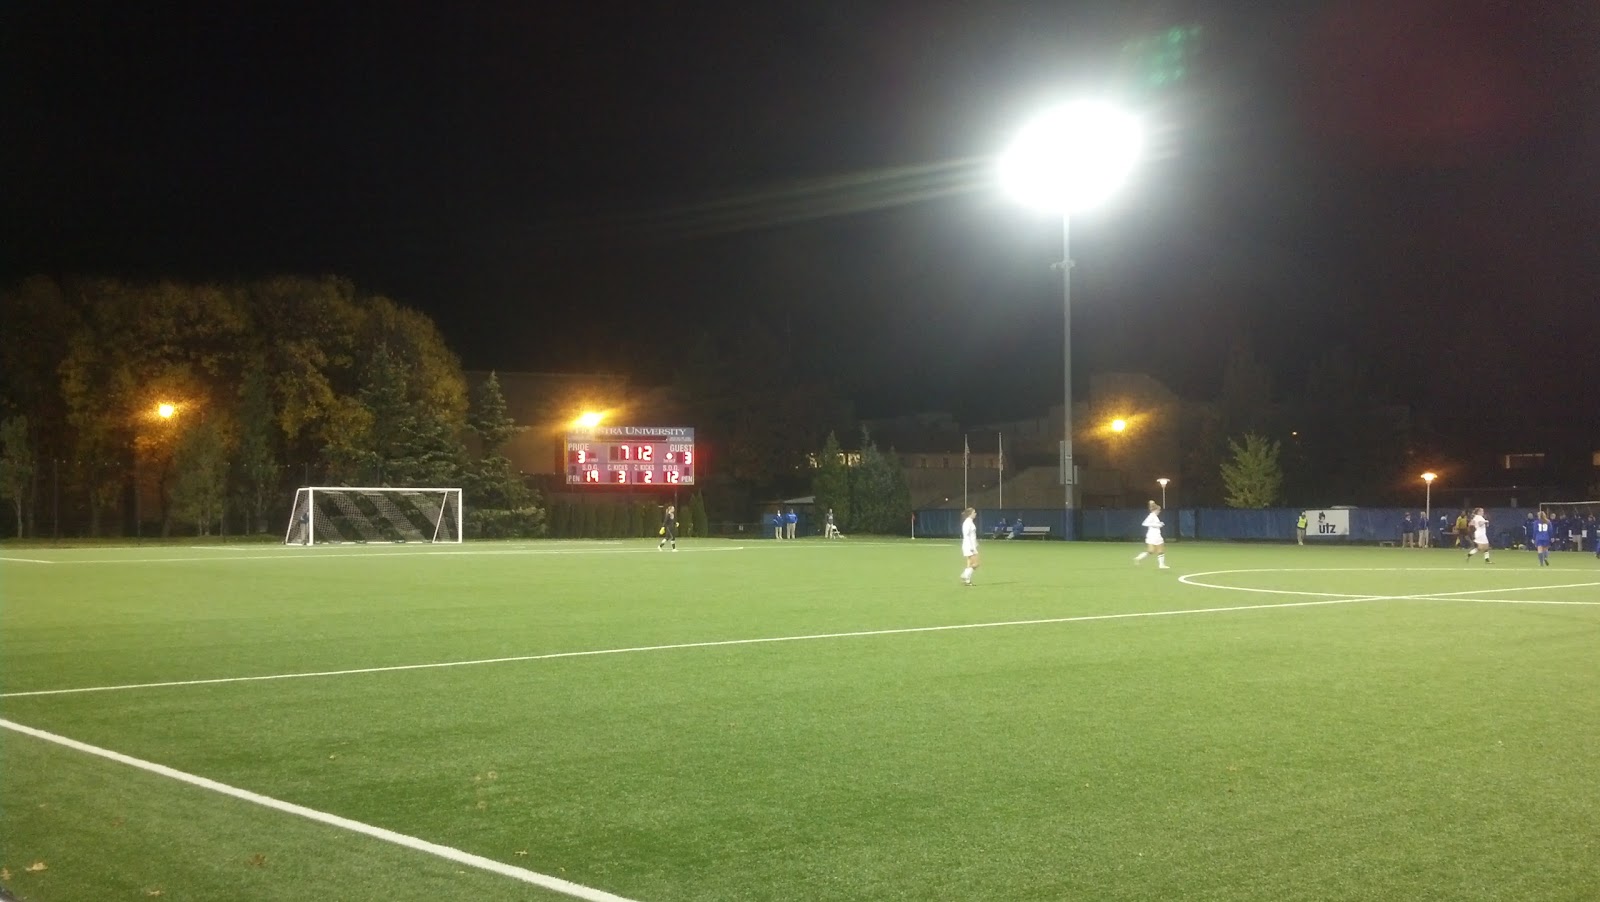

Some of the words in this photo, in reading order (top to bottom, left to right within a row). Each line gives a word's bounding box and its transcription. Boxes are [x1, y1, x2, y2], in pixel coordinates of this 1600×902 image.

[575, 427, 623, 435] HOSTRA
[625, 427, 686, 435] UNIVERSITY
[568, 443, 589, 451] PRIDE
[621, 445, 630, 459] 7
[637, 445, 652, 461] 12
[670, 444, 692, 452] GUEST
[578, 450, 586, 463] 3
[684, 451, 692, 464] 3
[586, 470, 599, 482] 19
[618, 470, 626, 483] 3
[644, 470, 653, 484] 2
[666, 471, 679, 484] 12
